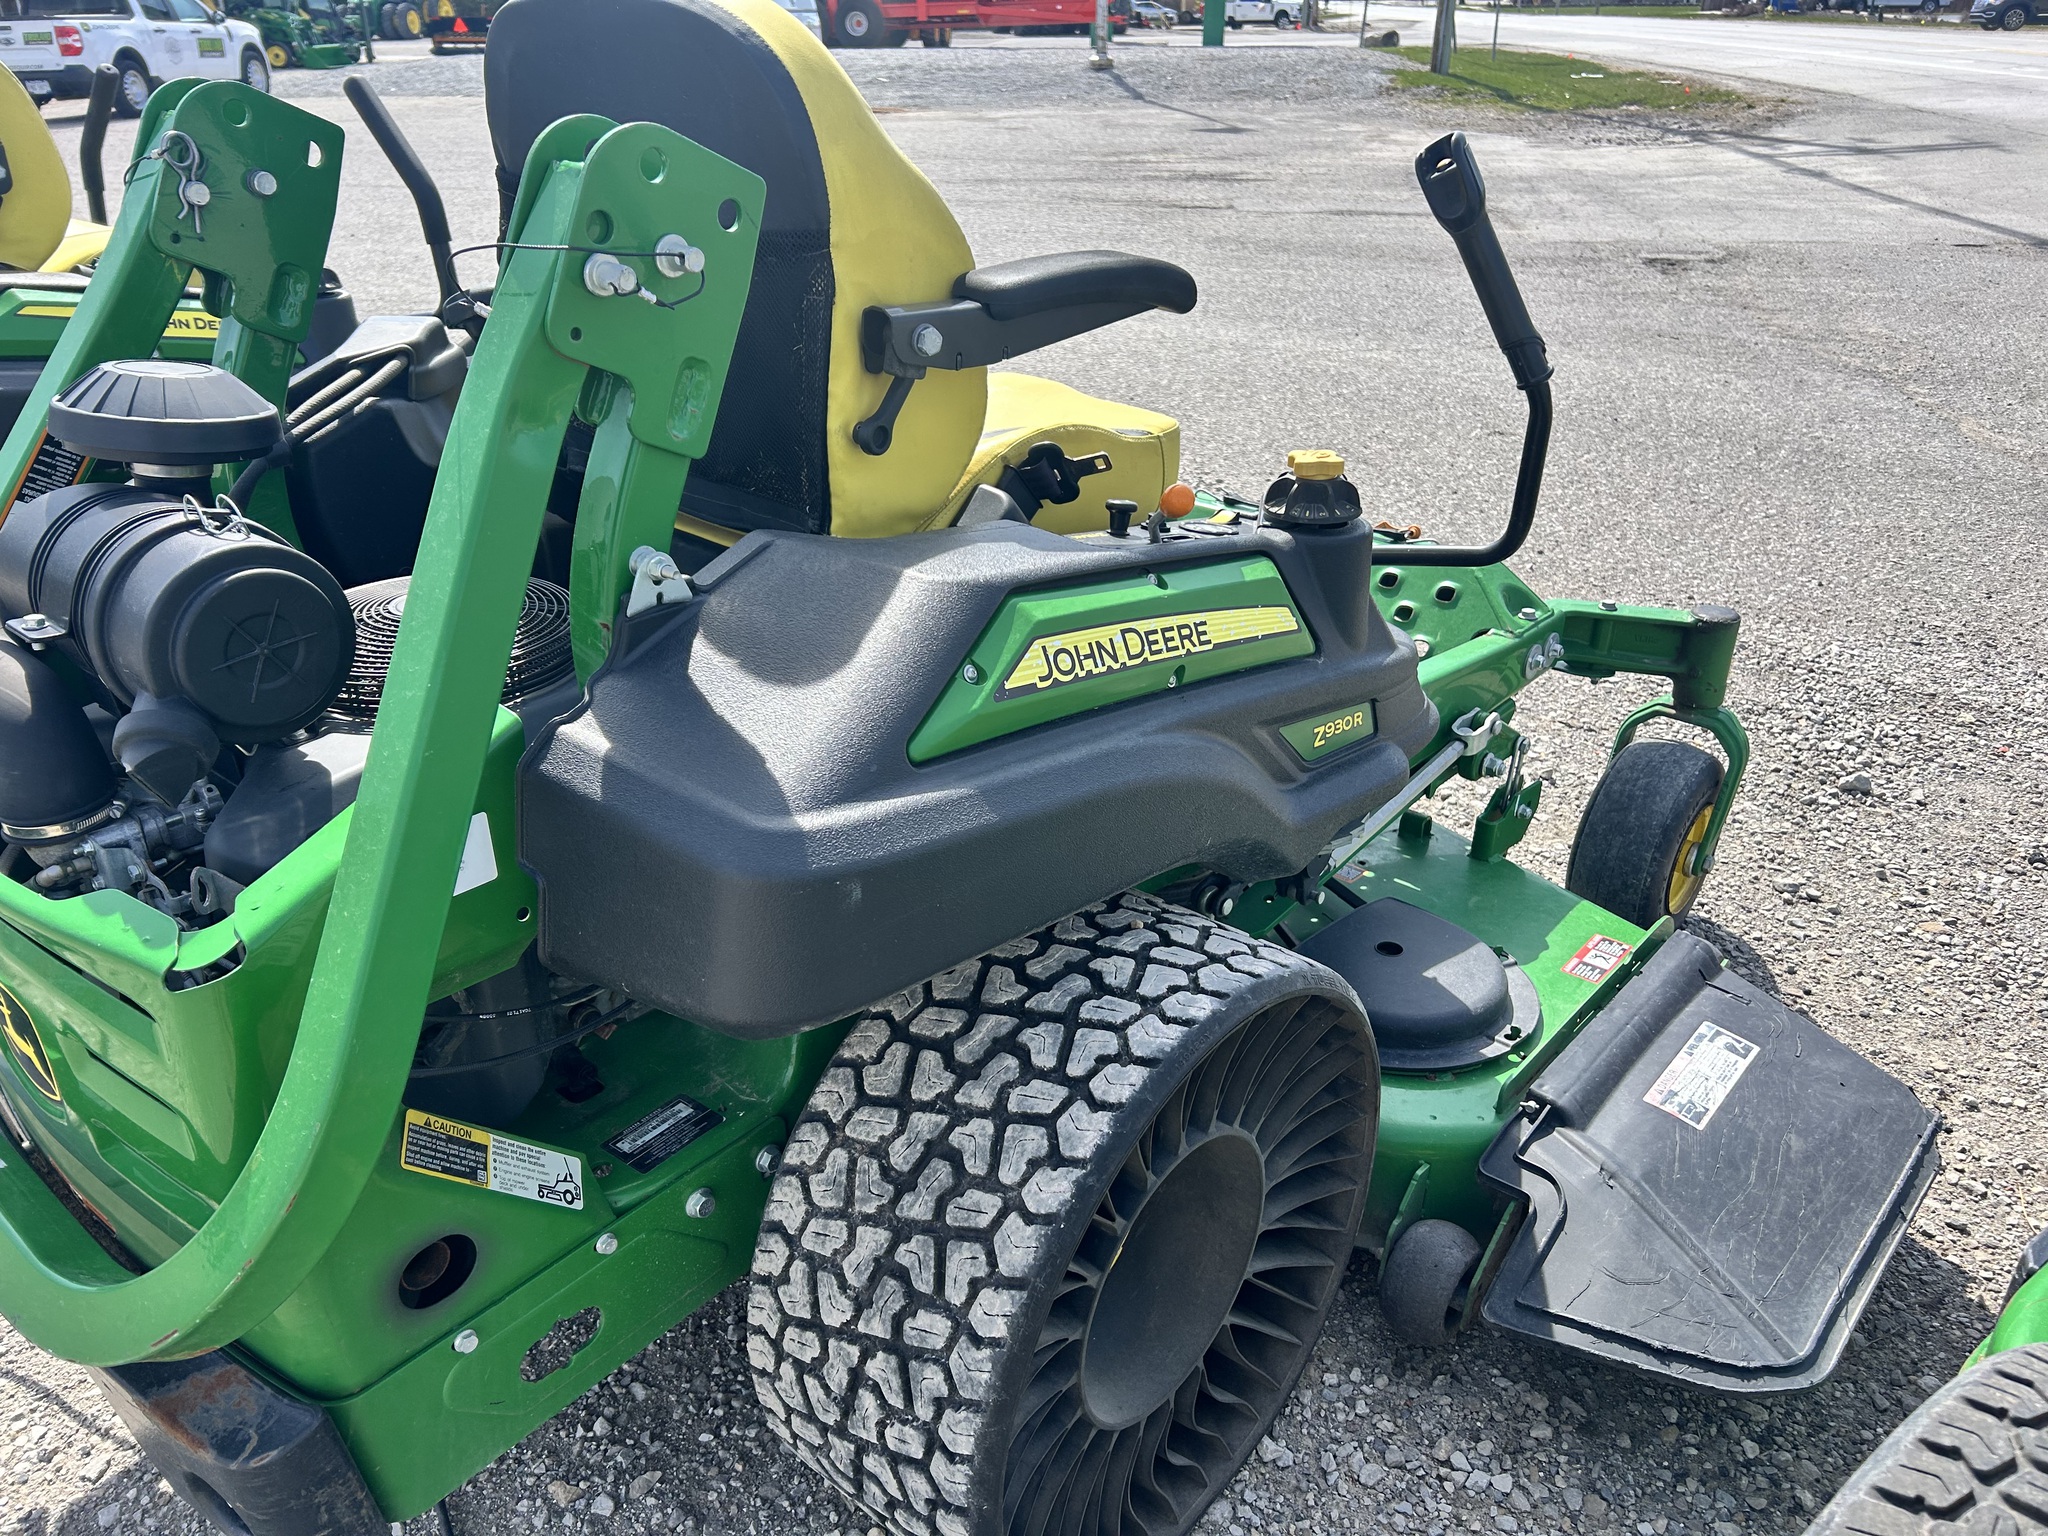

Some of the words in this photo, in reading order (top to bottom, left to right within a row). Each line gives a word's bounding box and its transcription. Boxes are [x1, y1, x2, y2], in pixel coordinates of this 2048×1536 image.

[193, 317, 221, 330] DE
[1037, 636, 1120, 684] JOHN
[1120, 620, 1212, 660] DEERE
[1313, 710, 1363, 748] Z930R
[1658, 1069, 1677, 1090] DANGER
[433, 1119, 472, 1140] CAUTION
[493, 1136, 507, 1145] Inspect
[492, 1144, 509, 1153] machine
[527, 1153, 541, 1161] special
[492, 1150, 510, 1159] attention
[515, 1156, 527, 1164] these
